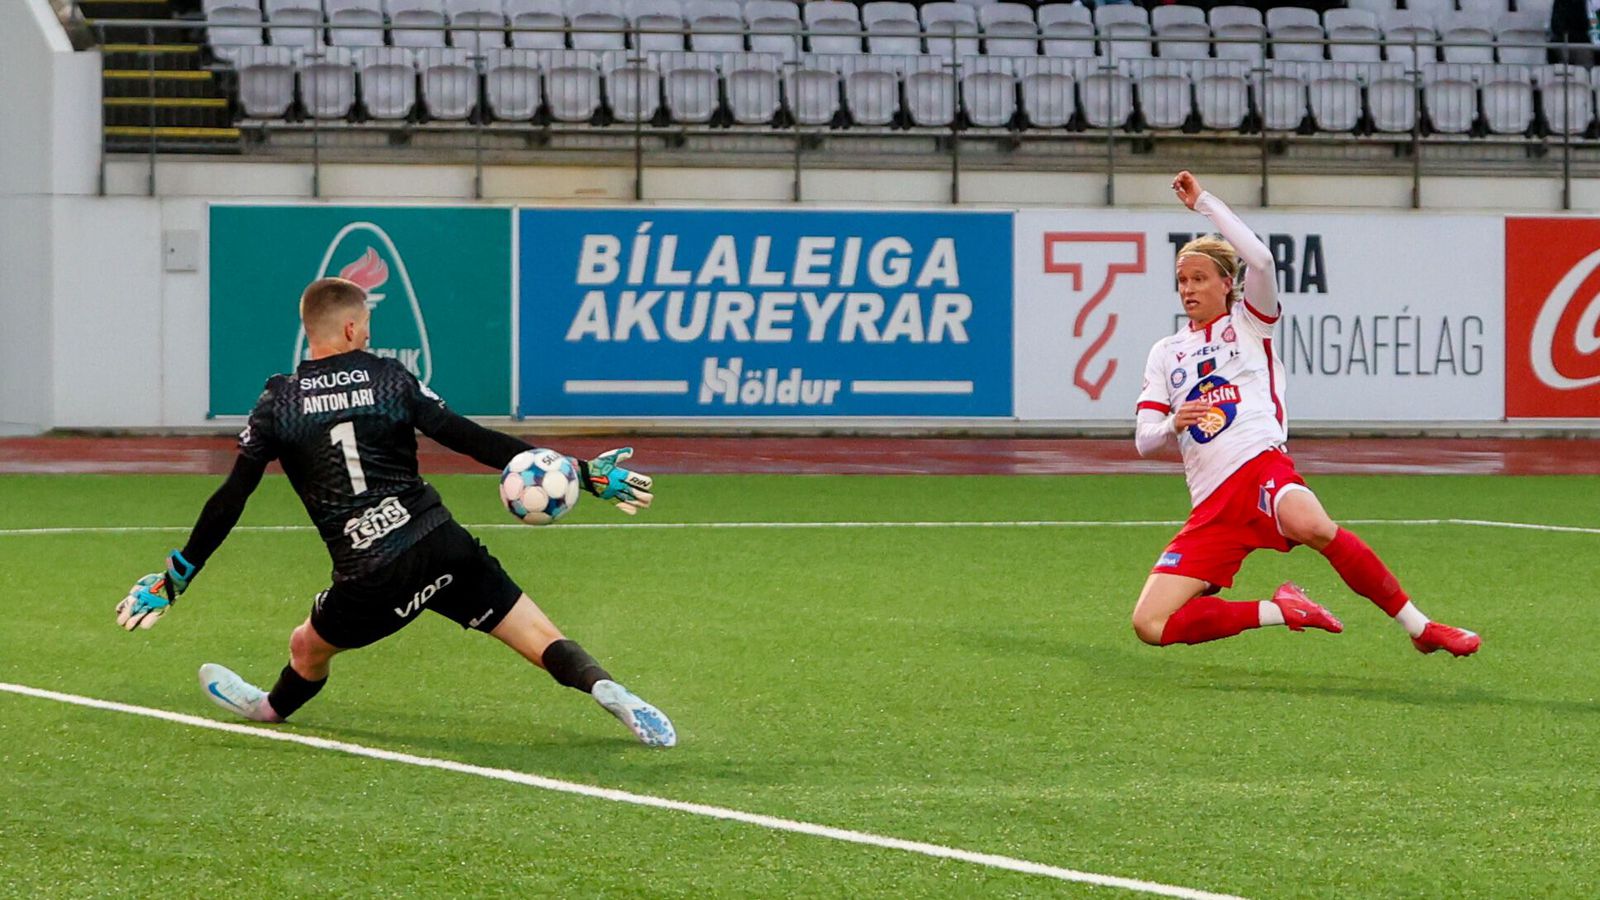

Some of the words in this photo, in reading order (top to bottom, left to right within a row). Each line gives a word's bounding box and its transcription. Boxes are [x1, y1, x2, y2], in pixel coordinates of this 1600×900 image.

[575, 221, 961, 287] BÍLALEIGA
[564, 290, 973, 343] AKUREYRAR
[1174, 305, 1484, 376] INGAFÉLAG
[300, 369, 370, 390] SKUGGI
[303, 391, 349, 415] ANTON
[351, 388, 375, 408] ARI
[699, 357, 841, 405] Höldur
[329, 421, 368, 496] 1
